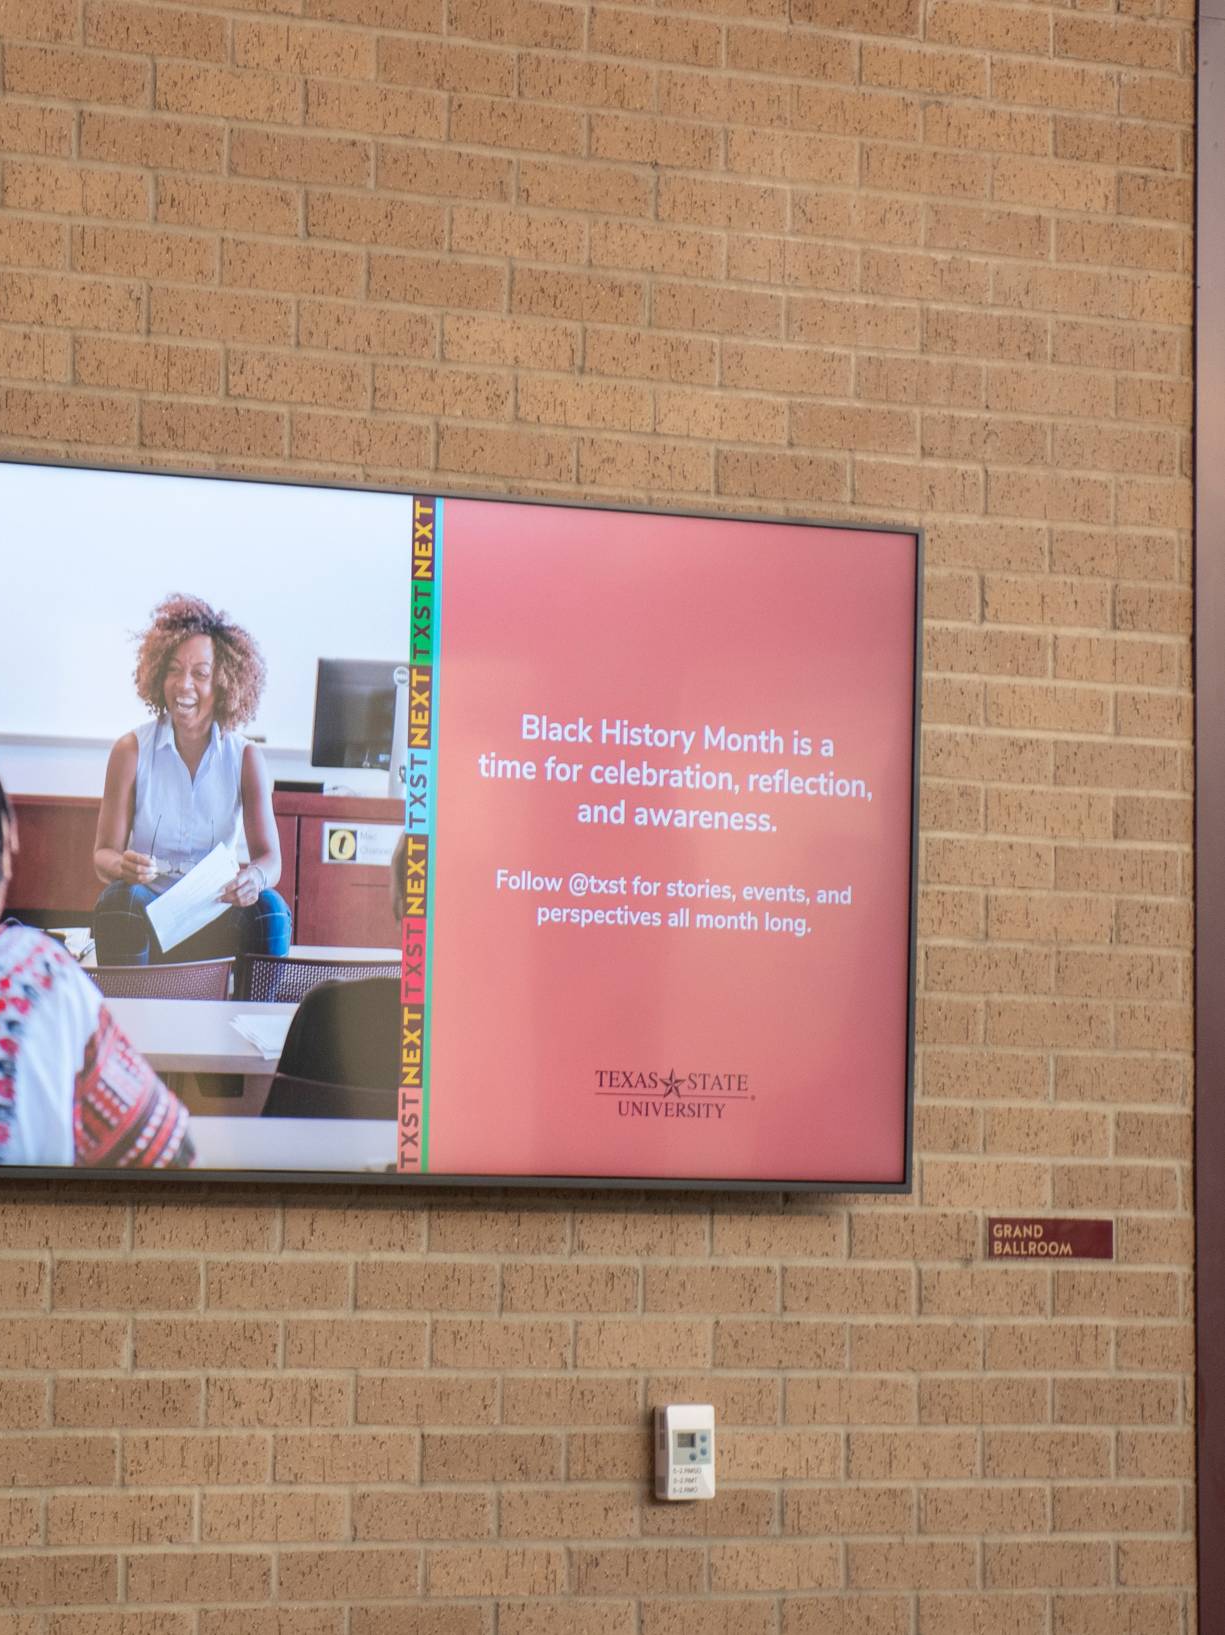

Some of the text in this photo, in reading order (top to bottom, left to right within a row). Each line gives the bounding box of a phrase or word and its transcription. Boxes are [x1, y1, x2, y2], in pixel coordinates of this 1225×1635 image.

[521, 714, 834, 757] Black History Month is a
[478, 753, 874, 802] time for celebration, reflection,
[577, 800, 778, 832] and awareness.
[400, 500, 433, 1169] TXST NEXT TXST NEXT TXST NEXT TXST NEXT
[495, 869, 852, 905] Follow @txst for stories, events, and
[537, 903, 812, 937] perspectives all month long.
[594, 1069, 749, 1092] TEXAS STATE
[617, 1100, 727, 1119] UNIVERSITY
[992, 1223, 1044, 1239] GRAND
[993, 1241, 1073, 1256] BALLROOM
